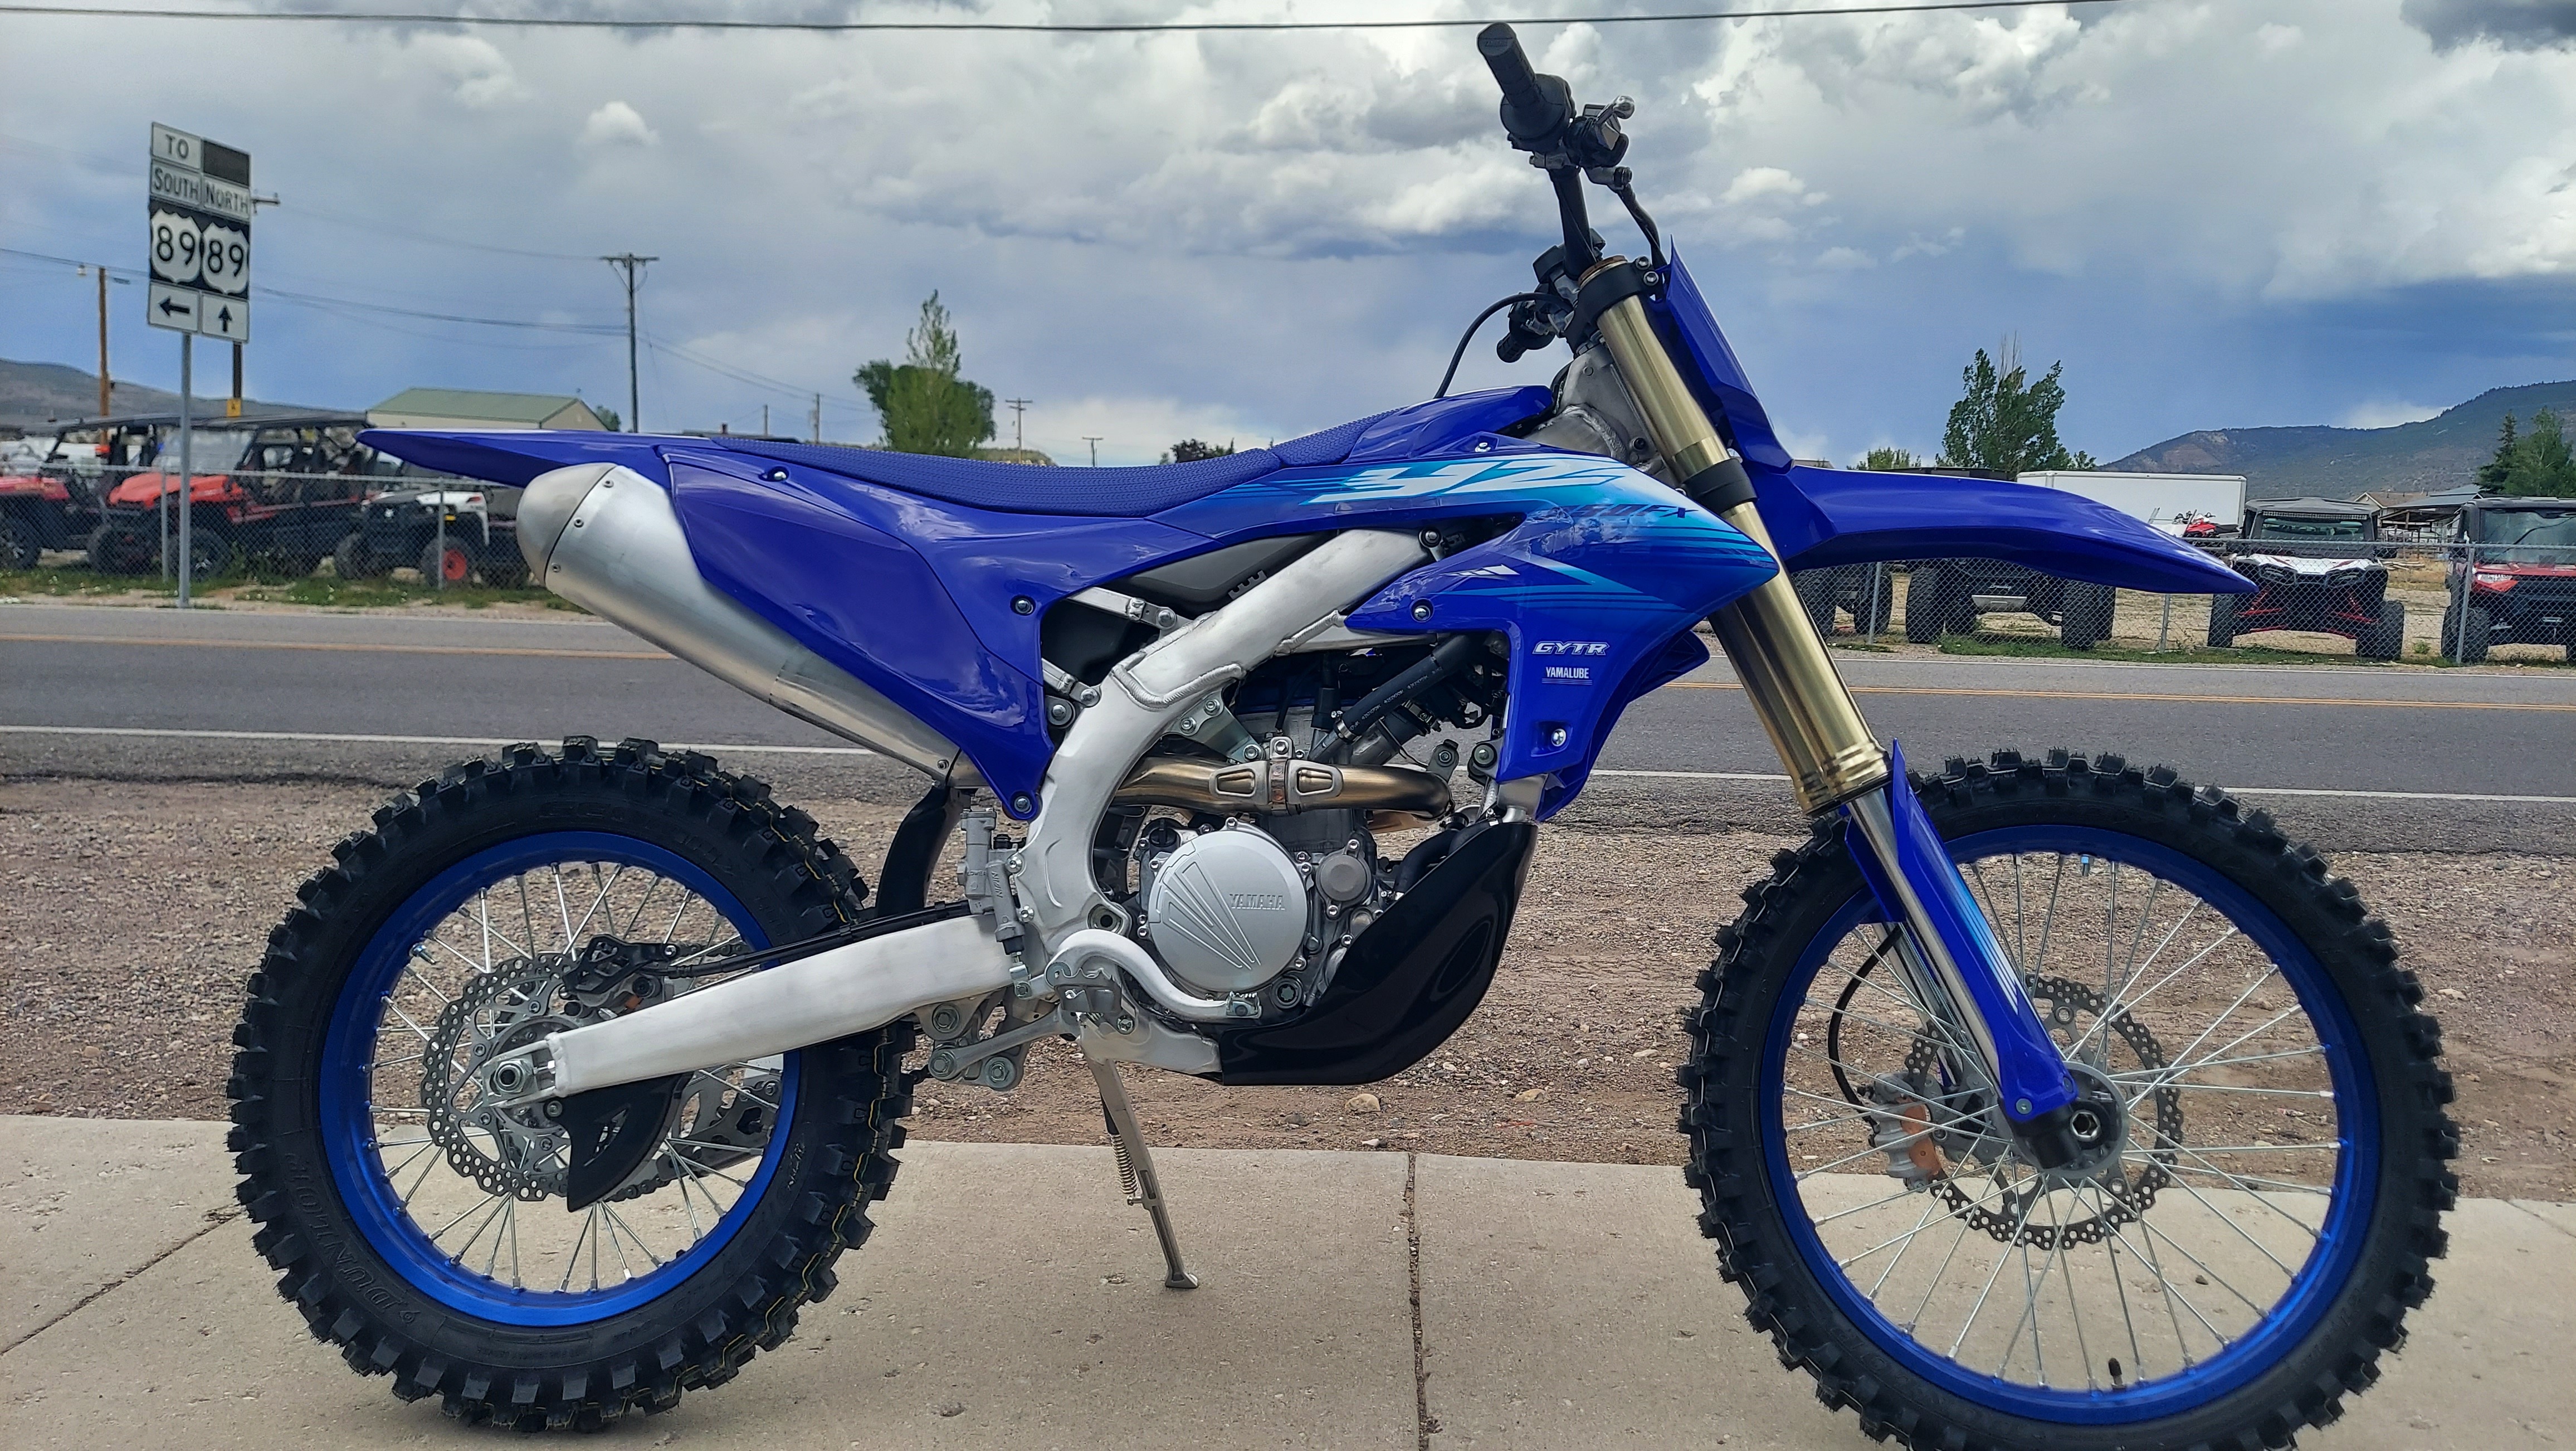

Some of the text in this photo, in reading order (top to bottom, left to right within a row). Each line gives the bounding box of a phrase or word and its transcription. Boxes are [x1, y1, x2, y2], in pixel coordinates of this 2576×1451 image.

[165, 134, 189, 159] TO
[154, 167, 199, 201] SOUTH
[206, 183, 249, 215] NORTH
[157, 226, 196, 266] 89
[208, 240, 244, 277] 89
[1532, 641, 1610, 655] GYTR
[1545, 666, 1589, 679] YAMALUBE
[1229, 894, 1285, 910] YAMAHA
